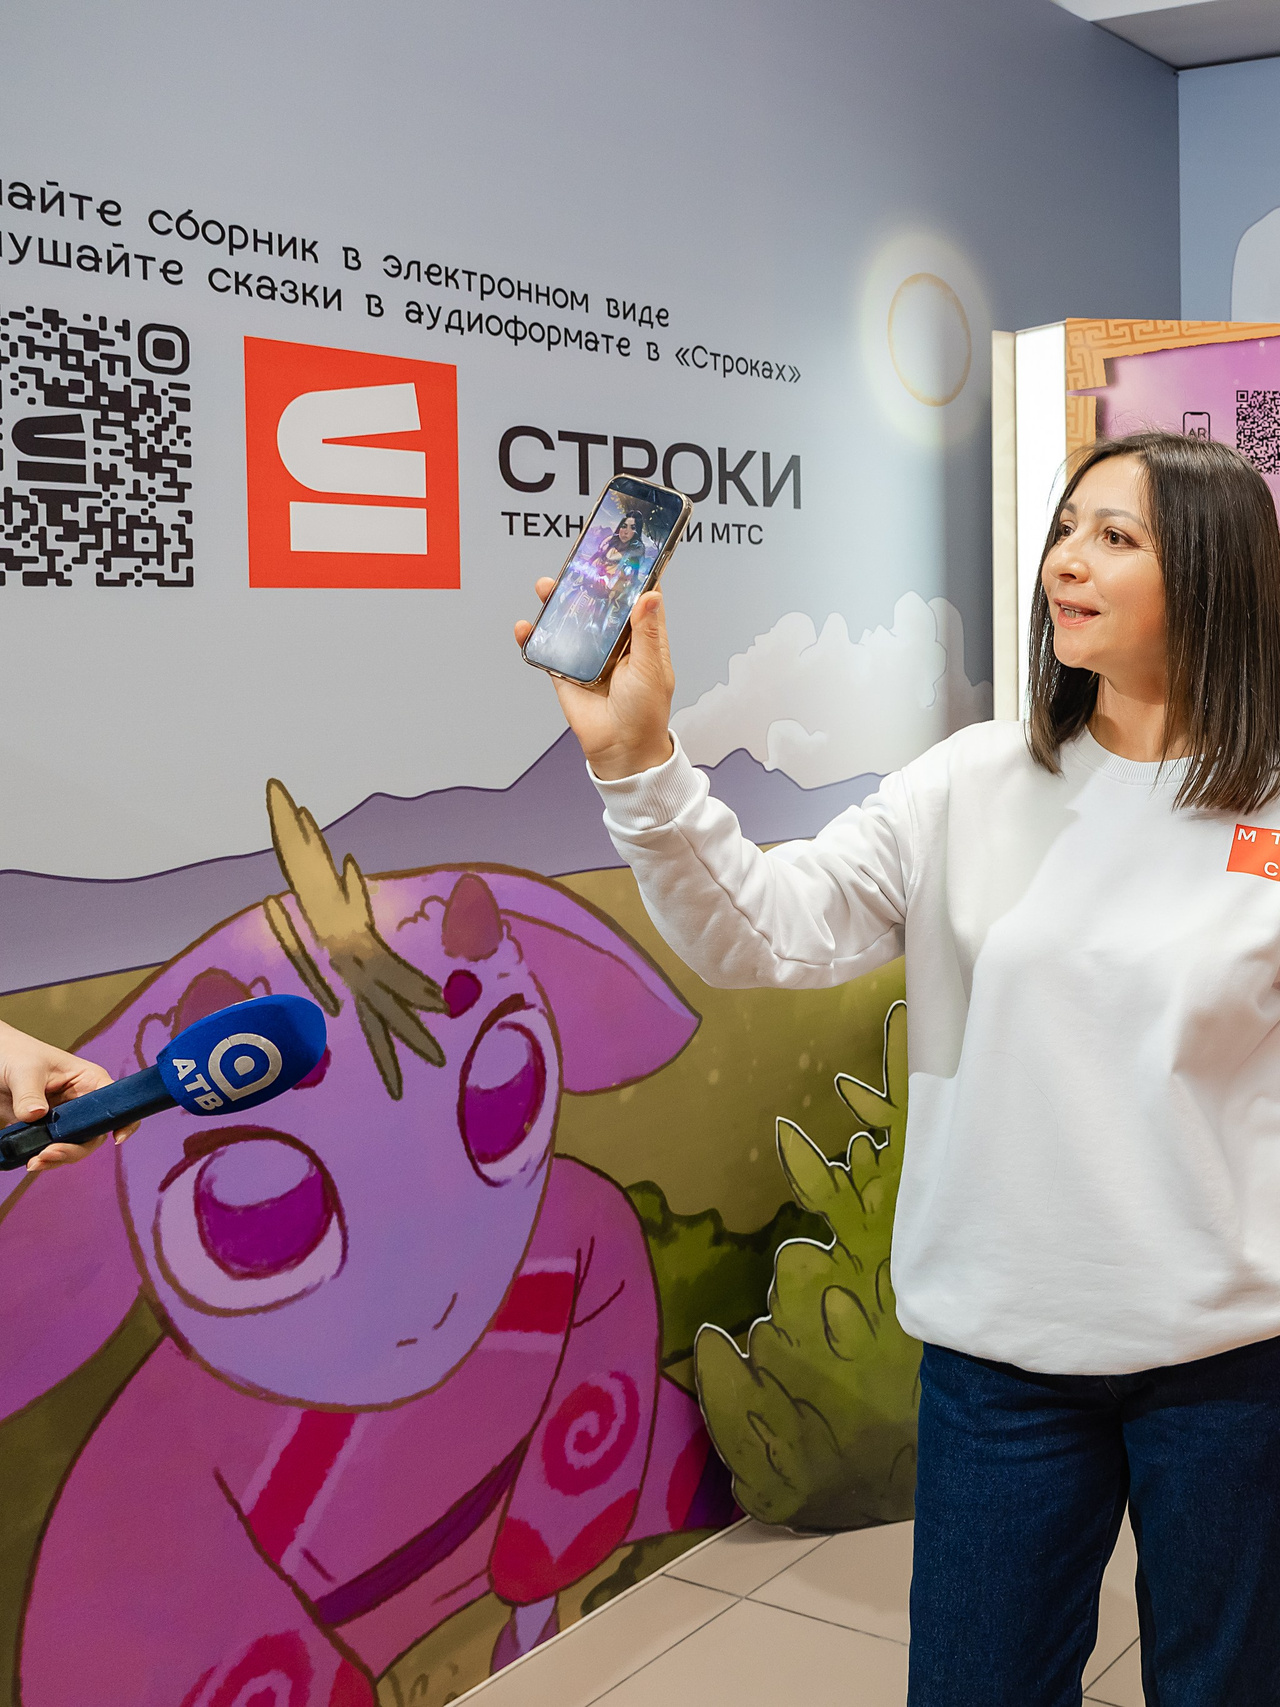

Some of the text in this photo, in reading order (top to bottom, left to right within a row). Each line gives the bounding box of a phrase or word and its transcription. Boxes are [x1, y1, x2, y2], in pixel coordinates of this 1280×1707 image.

[0, 179, 670, 329] айте сборник в электронном виде
[0, 231, 802, 385] ушайте сказки в аудиоформате в «Строках»
[499, 425, 801, 509] СТРОКИ
[711, 522, 763, 545] МТС
